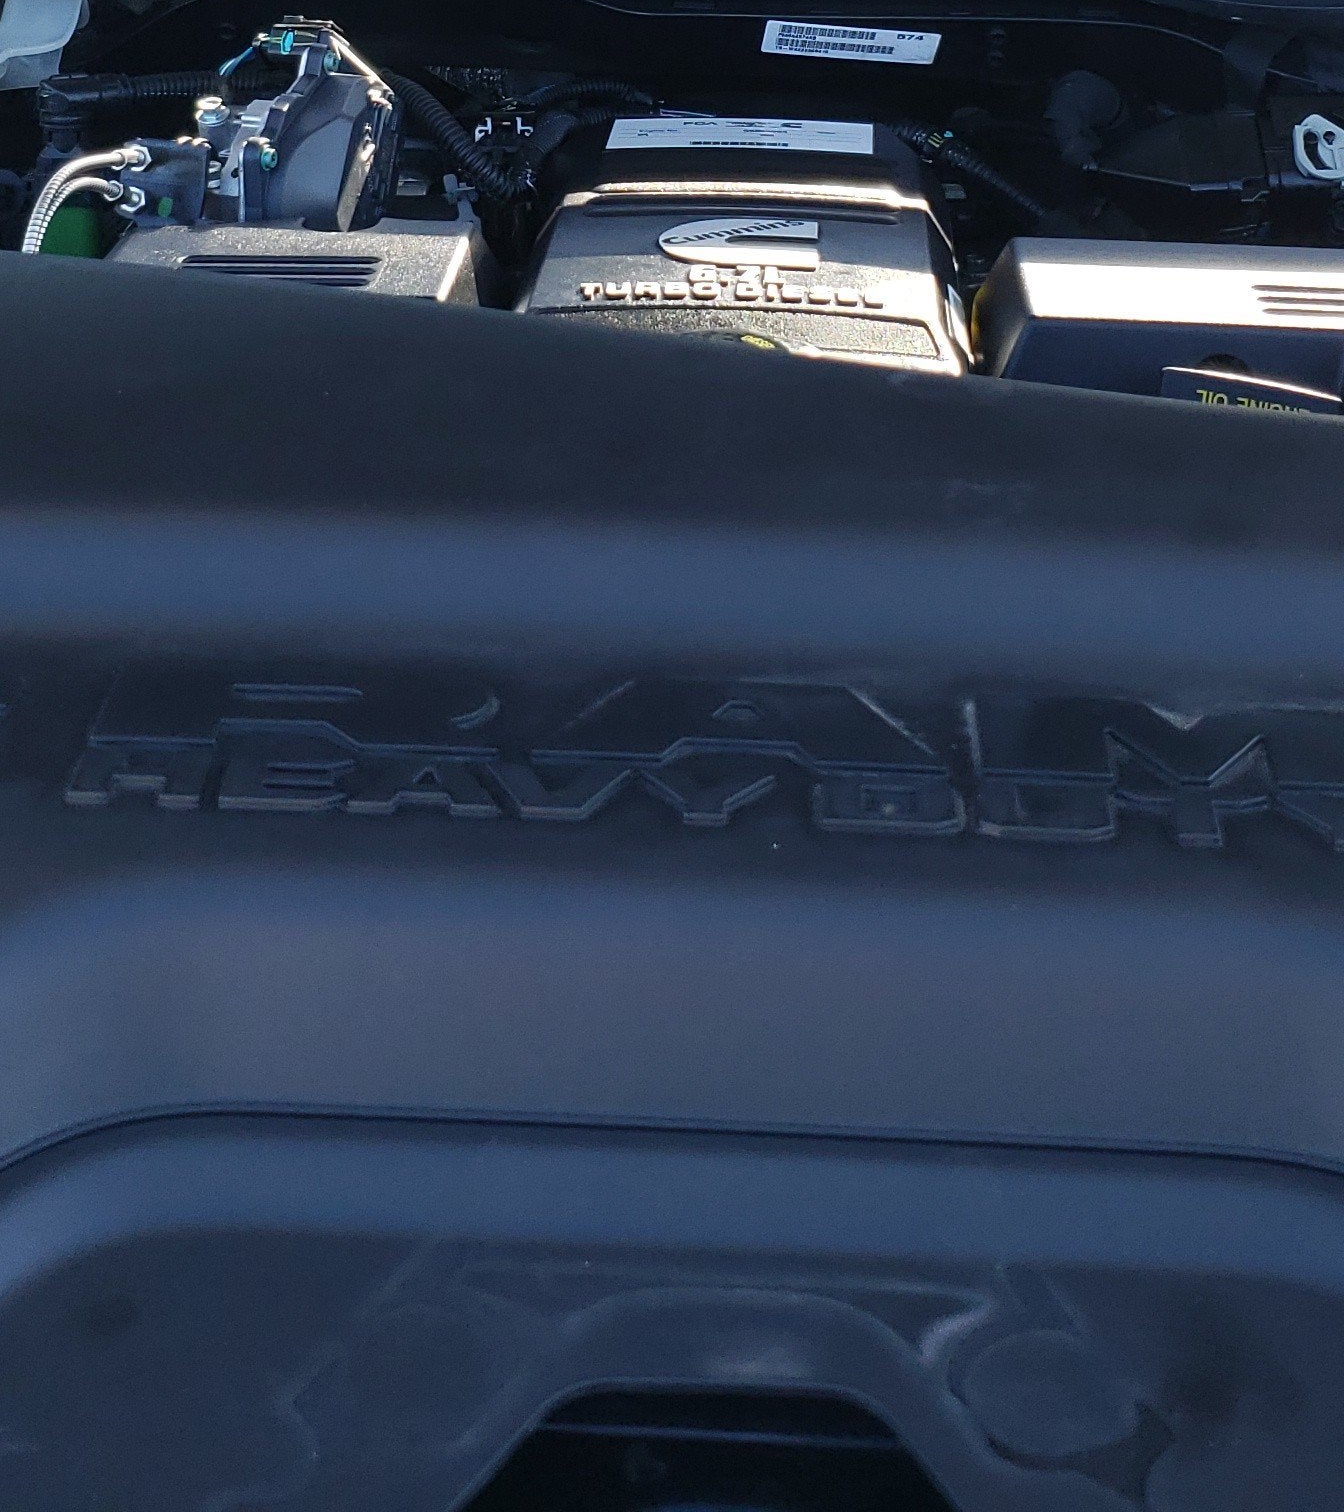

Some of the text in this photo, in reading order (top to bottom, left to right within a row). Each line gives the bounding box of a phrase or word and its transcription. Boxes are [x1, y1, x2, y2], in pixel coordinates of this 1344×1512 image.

[579, 281, 885, 309] TURBO DIESEL
[63, 720, 778, 826] HEAVY
